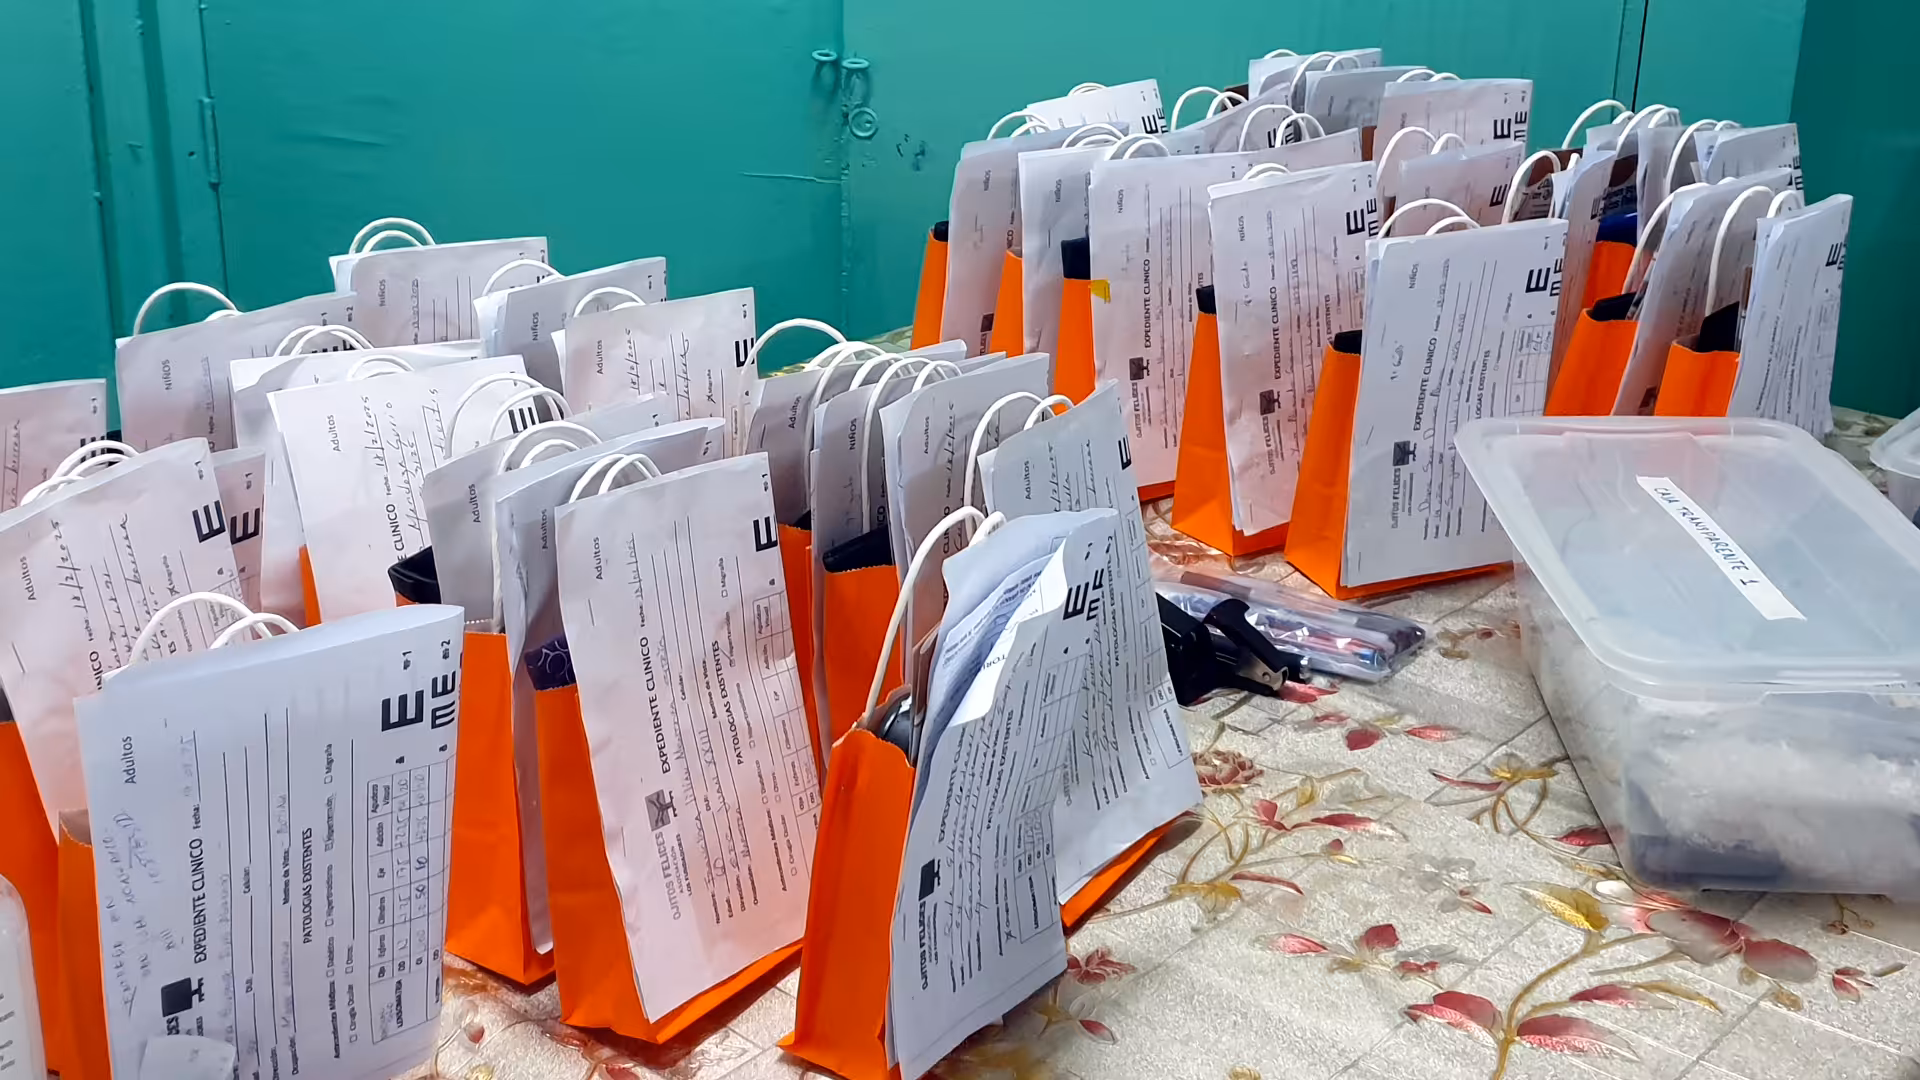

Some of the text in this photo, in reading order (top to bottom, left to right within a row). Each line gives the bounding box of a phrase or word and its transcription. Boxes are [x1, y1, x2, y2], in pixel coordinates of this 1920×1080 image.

[1493, 118, 1511, 139] E
[983, 170, 992, 191] NIÑOS
[1054, 179, 1062, 203] NIÑOS
[1238, 216, 1246, 241] NIÑOS
[1346, 208, 1366, 235] E
[1408, 263, 1419, 288] NIÑOS
[1524, 267, 1551, 293] E
[378, 279, 387, 307] NIÑOS
[1143, 259, 1152, 347] EXPEDIENTE CLINICO
[531, 312, 540, 341] NIÑOS
[1324, 294, 1333, 334] EXISTENTES
[1270, 286, 1282, 379] EXPEDIENTE CLINICO
[596, 340, 604, 374] Adultos
[1478, 350, 1490, 390] EXISTENTES
[161, 359, 173, 390] NIÑOS
[1413, 338, 1438, 430] EXPEDIENTE CLINICO
[788, 396, 802, 428] Adultos
[1132, 382, 1140, 412] FELICES
[326, 414, 342, 452] Adultos
[848, 418, 858, 450] NIÑOS
[1262, 416, 1271, 448] FELICES
[382, 474, 392, 496] Fecha:
[1022, 460, 1032, 500] Adultos
[1392, 468, 1401, 500] FELICES
[1654, 487, 1680, 504] CAJA
[466, 483, 482, 524] Adultos
[192, 500, 227, 544] E
[230, 508, 261, 546] E
[385, 504, 406, 552] CLINICO
[540, 508, 550, 550] Adultos
[160, 556, 175, 586] Migraña
[592, 536, 604, 580] Adultos
[718, 557, 728, 588] Migraña
[18, 556, 38, 600] Adultos
[638, 604, 646, 628] Fecha:
[1062, 582, 1088, 621] E
[83, 616, 95, 641] Fecha:
[724, 611, 735, 657] Hipertensión
[755, 604, 764, 634] Agudeza
[639, 637, 656, 692] CLINICO
[762, 644, 771, 670] Adición
[432, 671, 456, 698] E
[678, 672, 688, 700] Celular:
[703, 681, 712, 690] de
[772, 690, 781, 702] Eje
[381, 690, 425, 732] E
[706, 692, 719, 720] Motivo
[712, 640, 744, 764] PATOLOGIAS EXISTENTES
[648, 694, 671, 774] EXPEDIENTE
[120, 735, 138, 784] Adultos
[324, 742, 336, 774] Migraña
[754, 758, 768, 794] Diabético
[370, 783, 381, 814] Agudeza
[382, 784, 392, 806] Visual
[704, 794, 712, 812] DUI:
[798, 796, 806, 810] Ojo
[770, 770, 797, 864] Cirugía Ocular Otros:
[375, 822, 386, 848] Adición
[242, 866, 253, 894] Celular:
[282, 867, 292, 878] de
[376, 867, 386, 878] Eje
[654, 831, 682, 920] OJITOS FELICES
[670, 846, 684, 894] ASOCIACIÓN
[772, 842, 787, 892] Antecedentes
[189, 804, 208, 964] EXPEDIENTE CLINICO Fecha:
[301, 826, 315, 944] PATOLOGIAS EXISTENTES
[734, 874, 746, 912] Dirección:
[746, 864, 760, 906] Ocupación:
[710, 892, 722, 924] Nombre:
[725, 896, 734, 918] Edad:
[324, 936, 336, 968] Diabético
